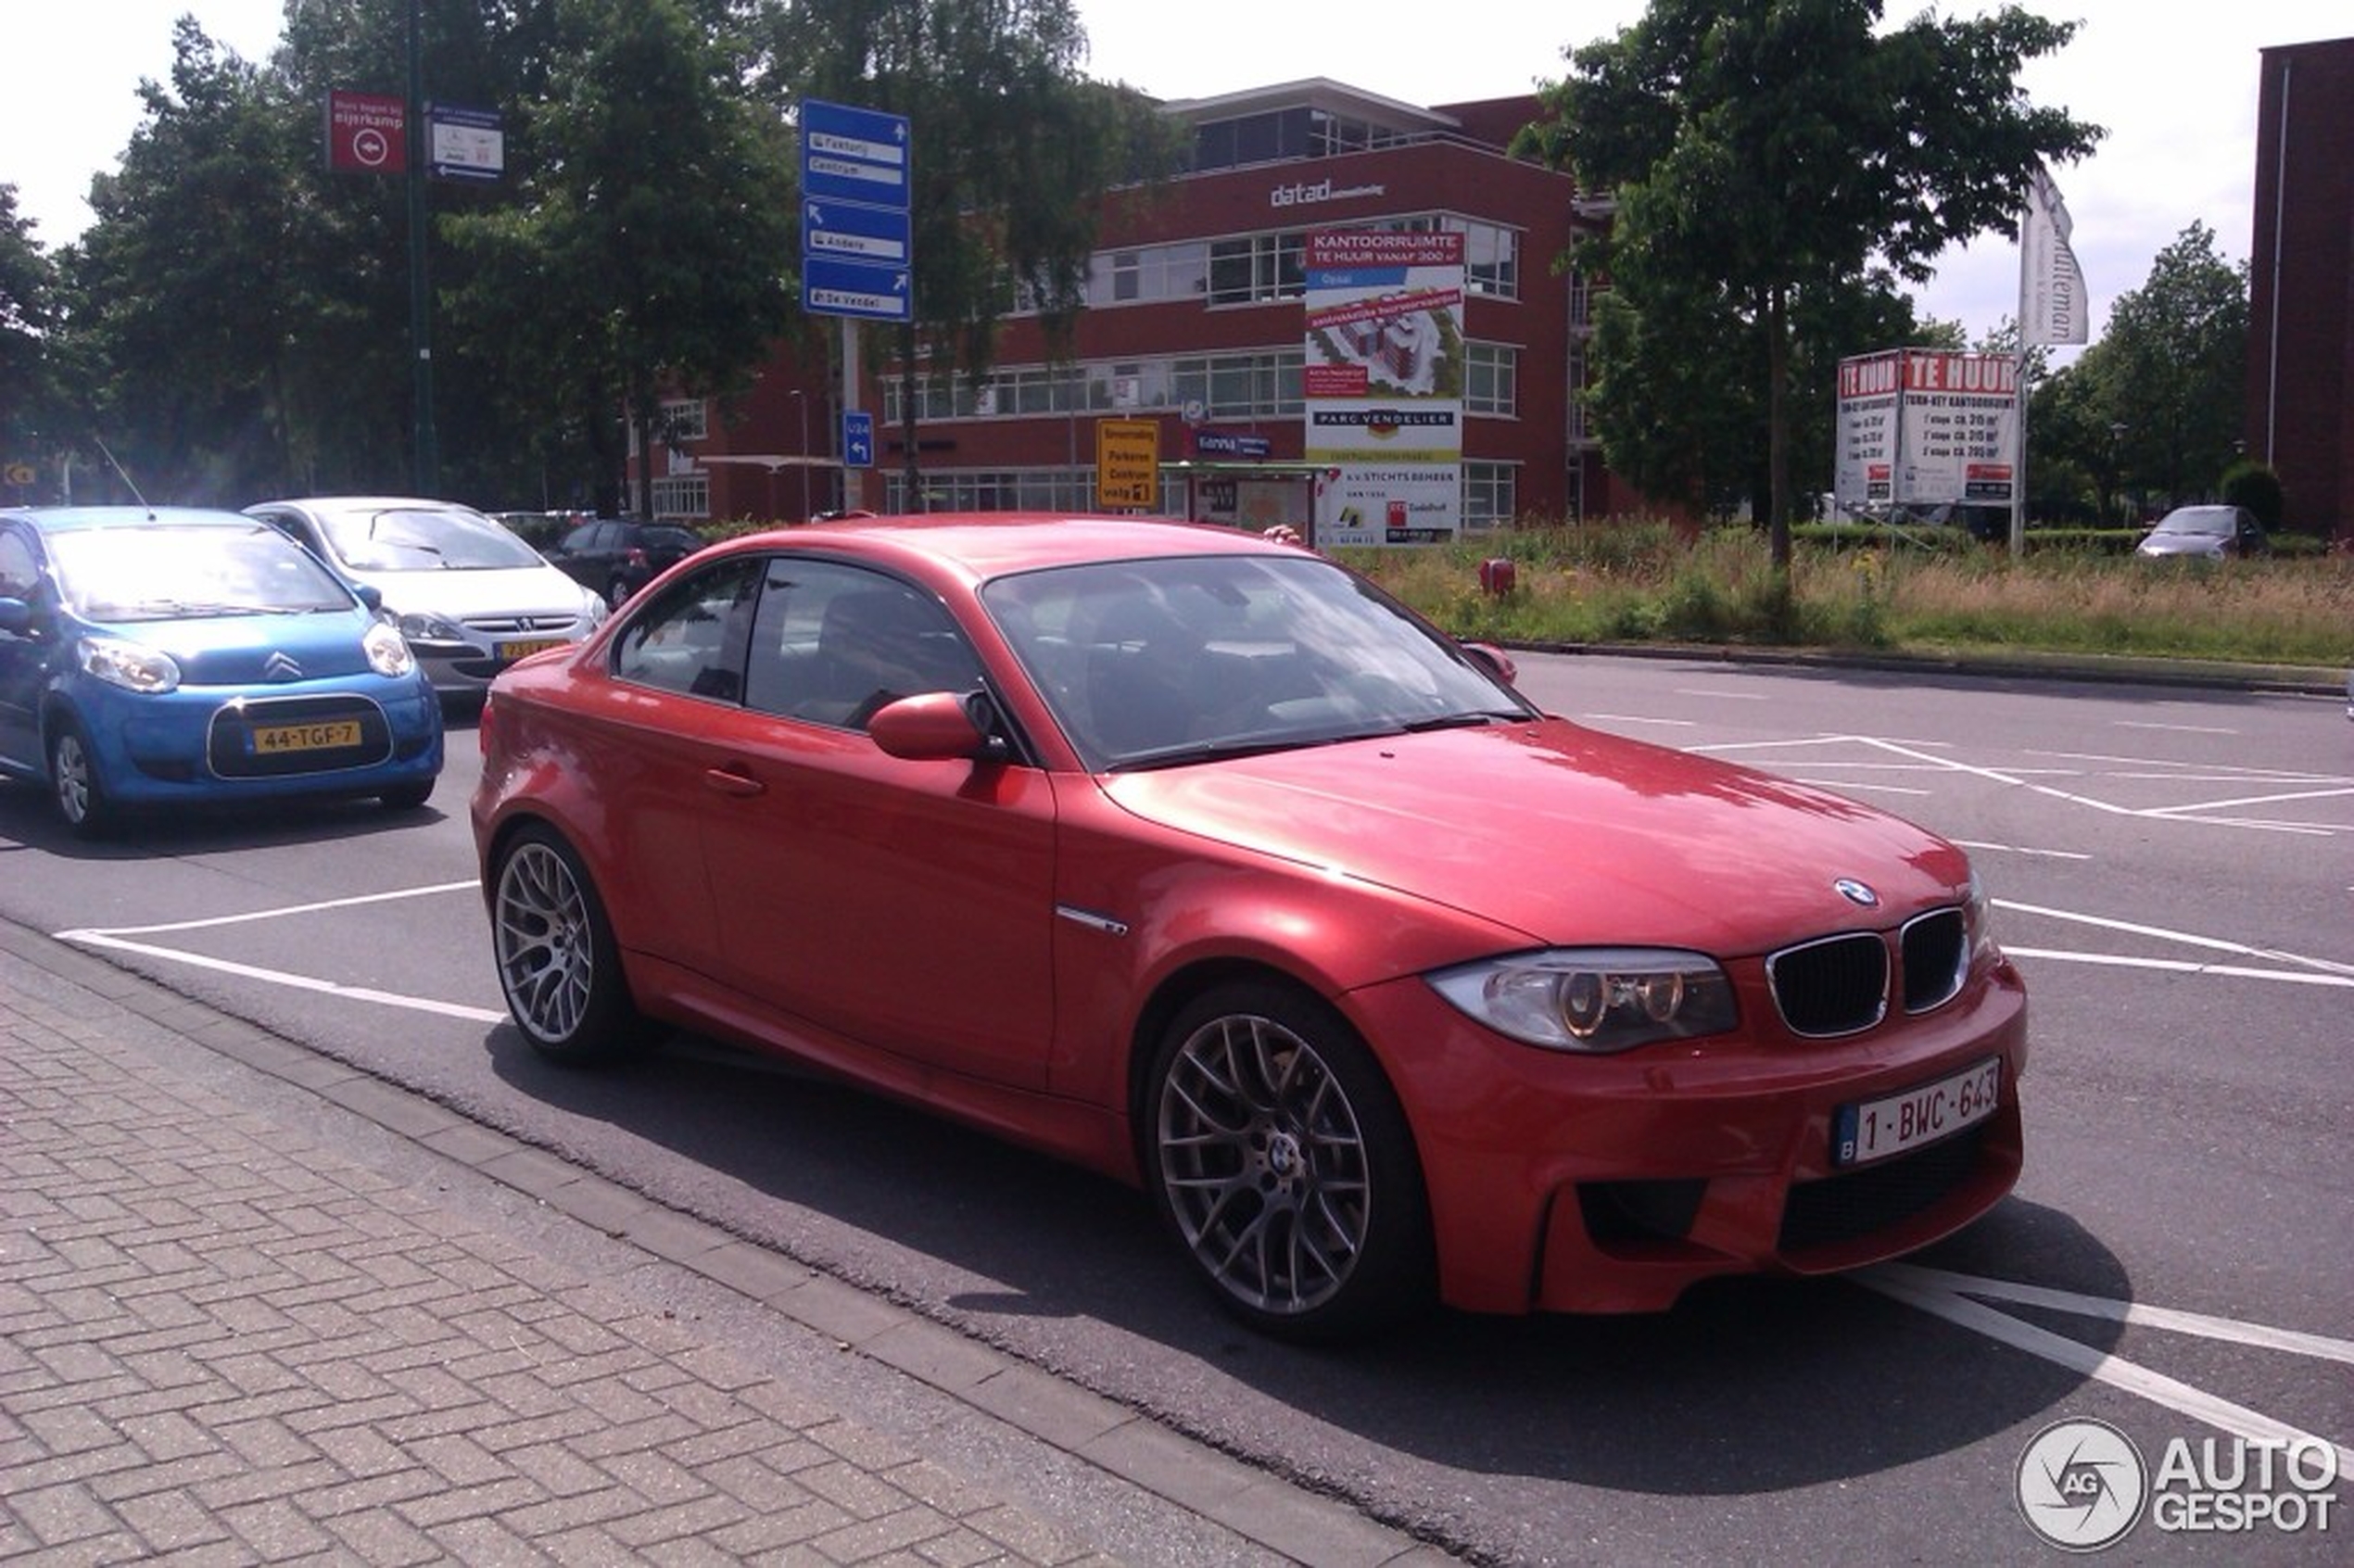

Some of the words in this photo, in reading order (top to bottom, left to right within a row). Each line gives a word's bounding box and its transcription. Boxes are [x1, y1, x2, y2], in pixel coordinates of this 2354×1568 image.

[812, 158, 859, 174] Centrum
[1314, 235, 1457, 248] KANTOORRUIMTE
[1315, 251, 1332, 262] TE
[1335, 251, 1373, 262] HUUR
[1375, 252, 1414, 262] VANAF
[1842, 366, 1857, 396] TE
[1859, 360, 1895, 394] HUUR
[1910, 358, 1939, 387] TE
[1947, 358, 2016, 392] HUUR
[1321, 414, 1358, 424] PARC
[1363, 414, 1449, 424] VENDELIER
[264, 726, 353, 749] 44-TGF-7
[1865, 1067, 1998, 1150] 1-BWC-643
[1841, 1142, 1854, 1158] B
